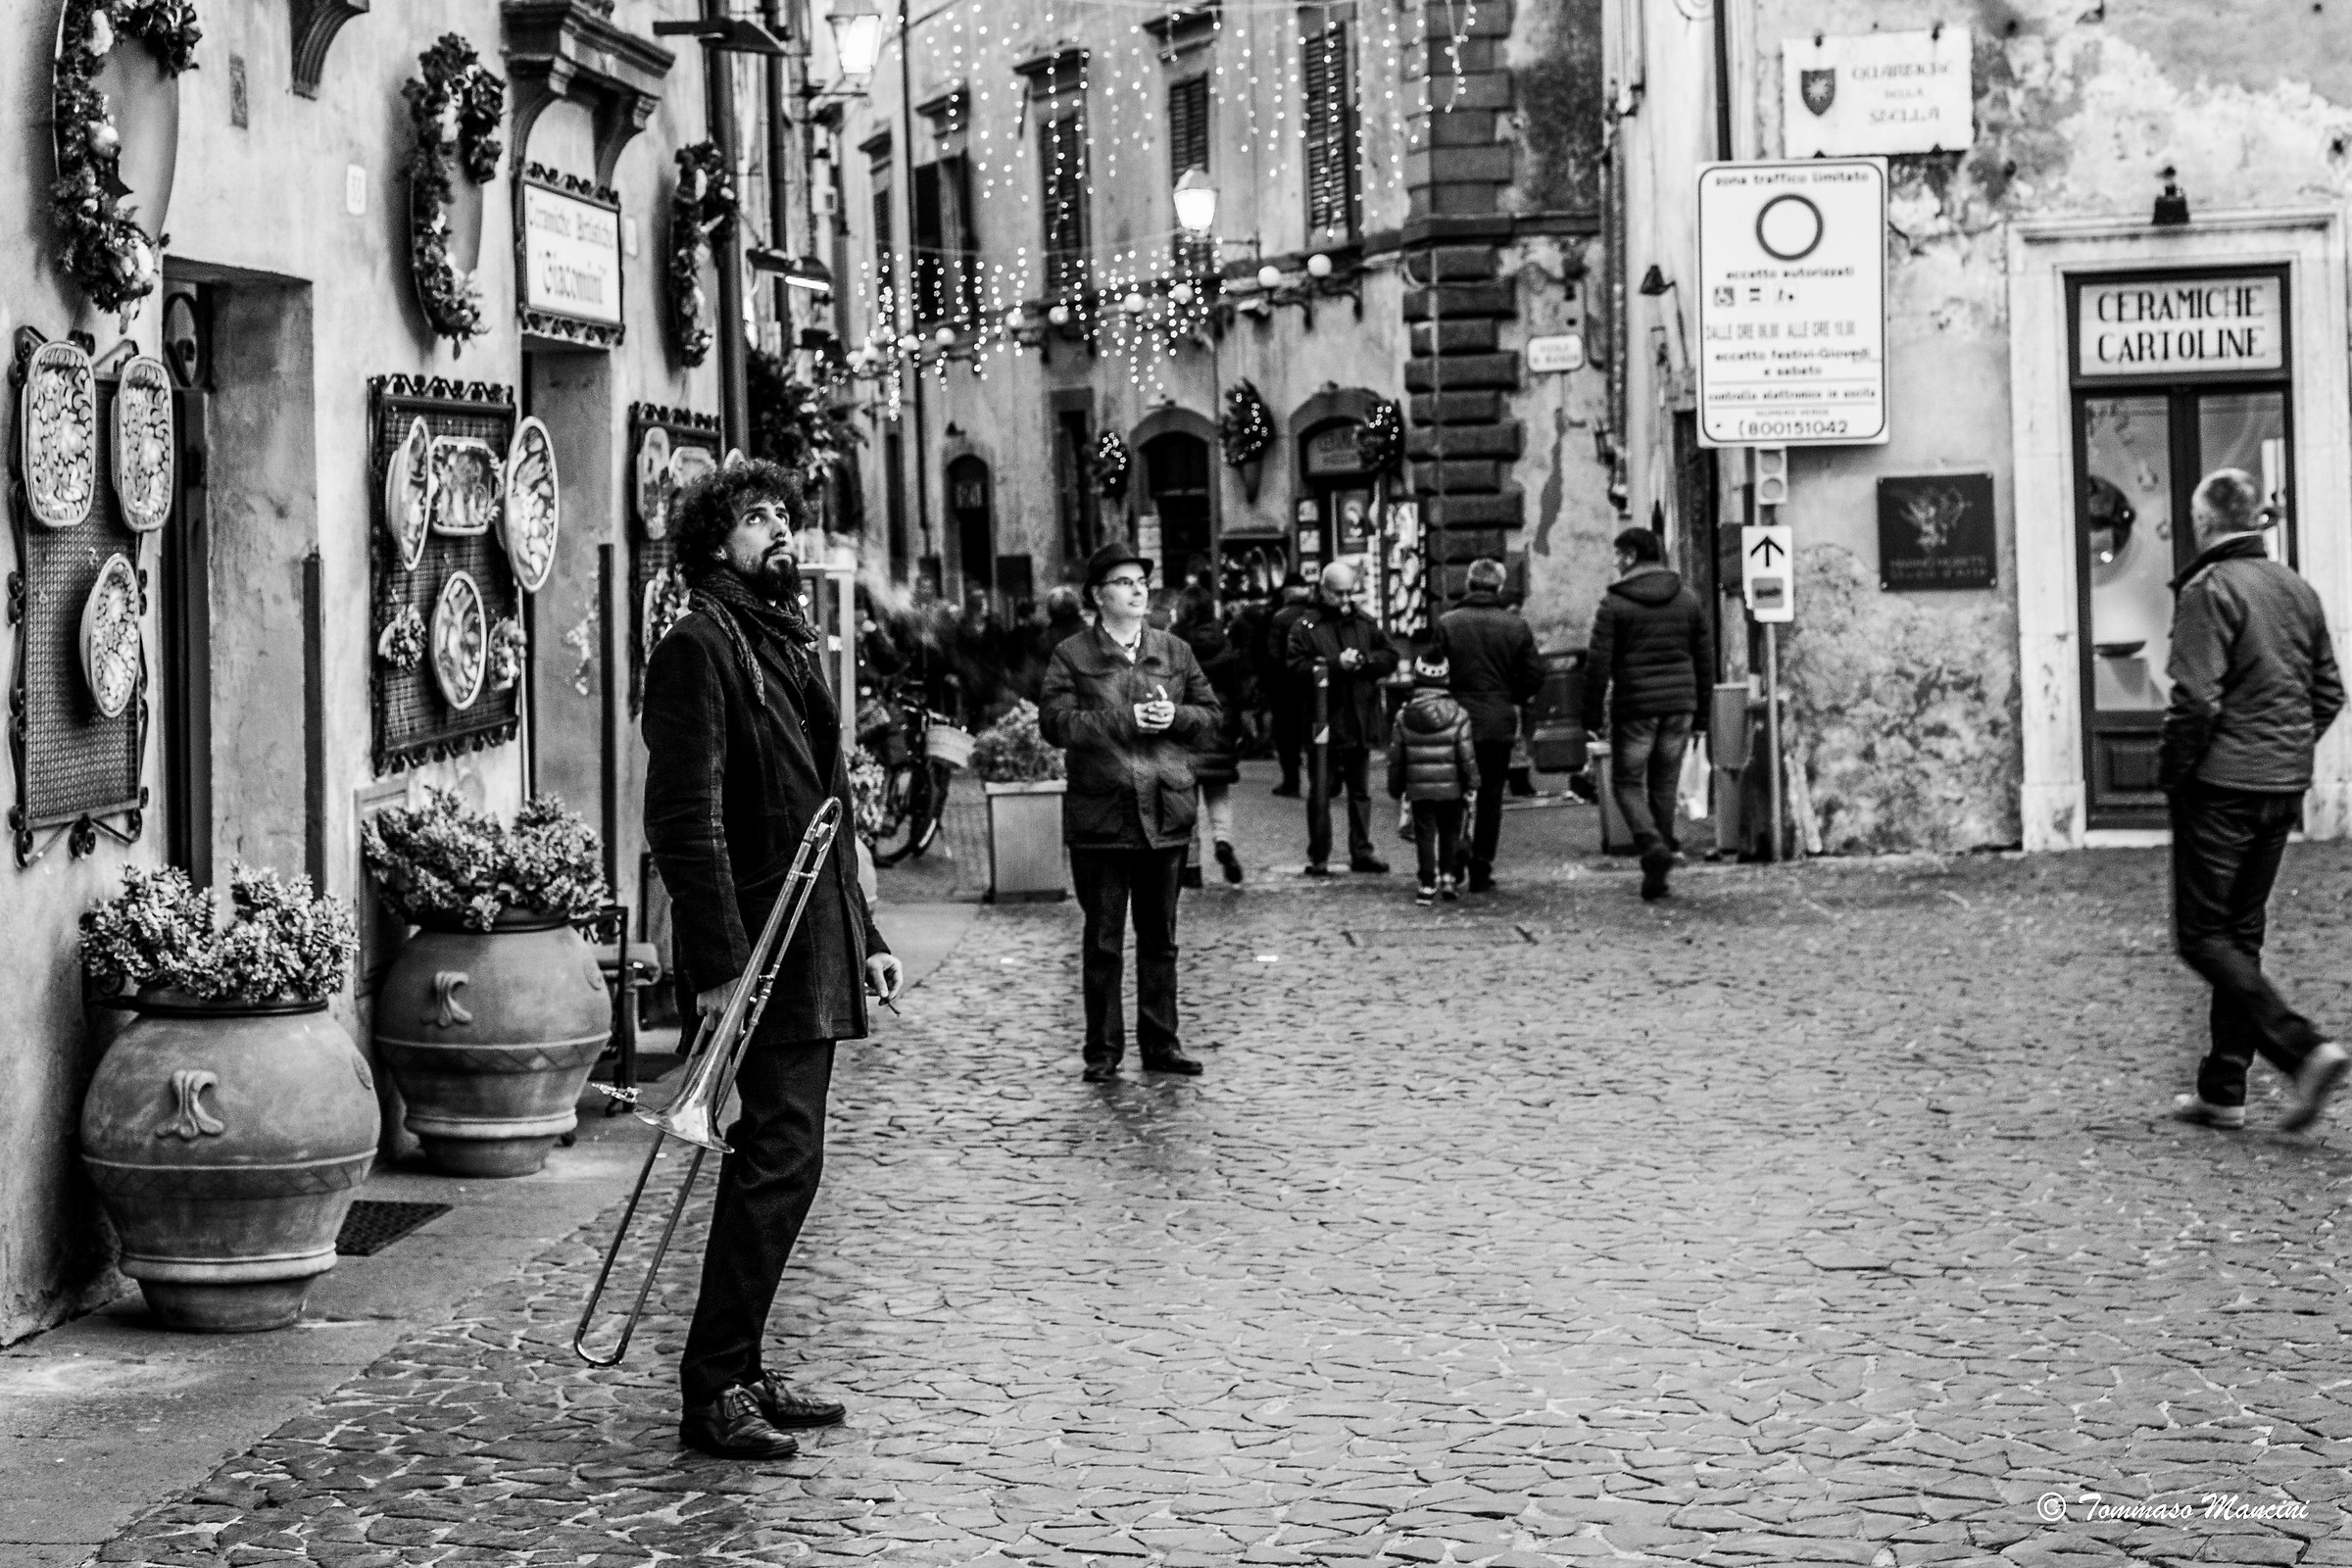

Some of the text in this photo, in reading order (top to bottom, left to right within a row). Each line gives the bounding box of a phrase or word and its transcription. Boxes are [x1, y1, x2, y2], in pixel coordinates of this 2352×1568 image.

[1715, 171, 1870, 186] zona traffico limitato
[1726, 267, 1855, 279] eccetto autorizzati
[2097, 285, 2265, 323] CERAMICHE
[2097, 325, 2266, 364] CARTOLINE
[1715, 350, 1766, 362] eccetto
[1777, 366, 1823, 376] sabato
